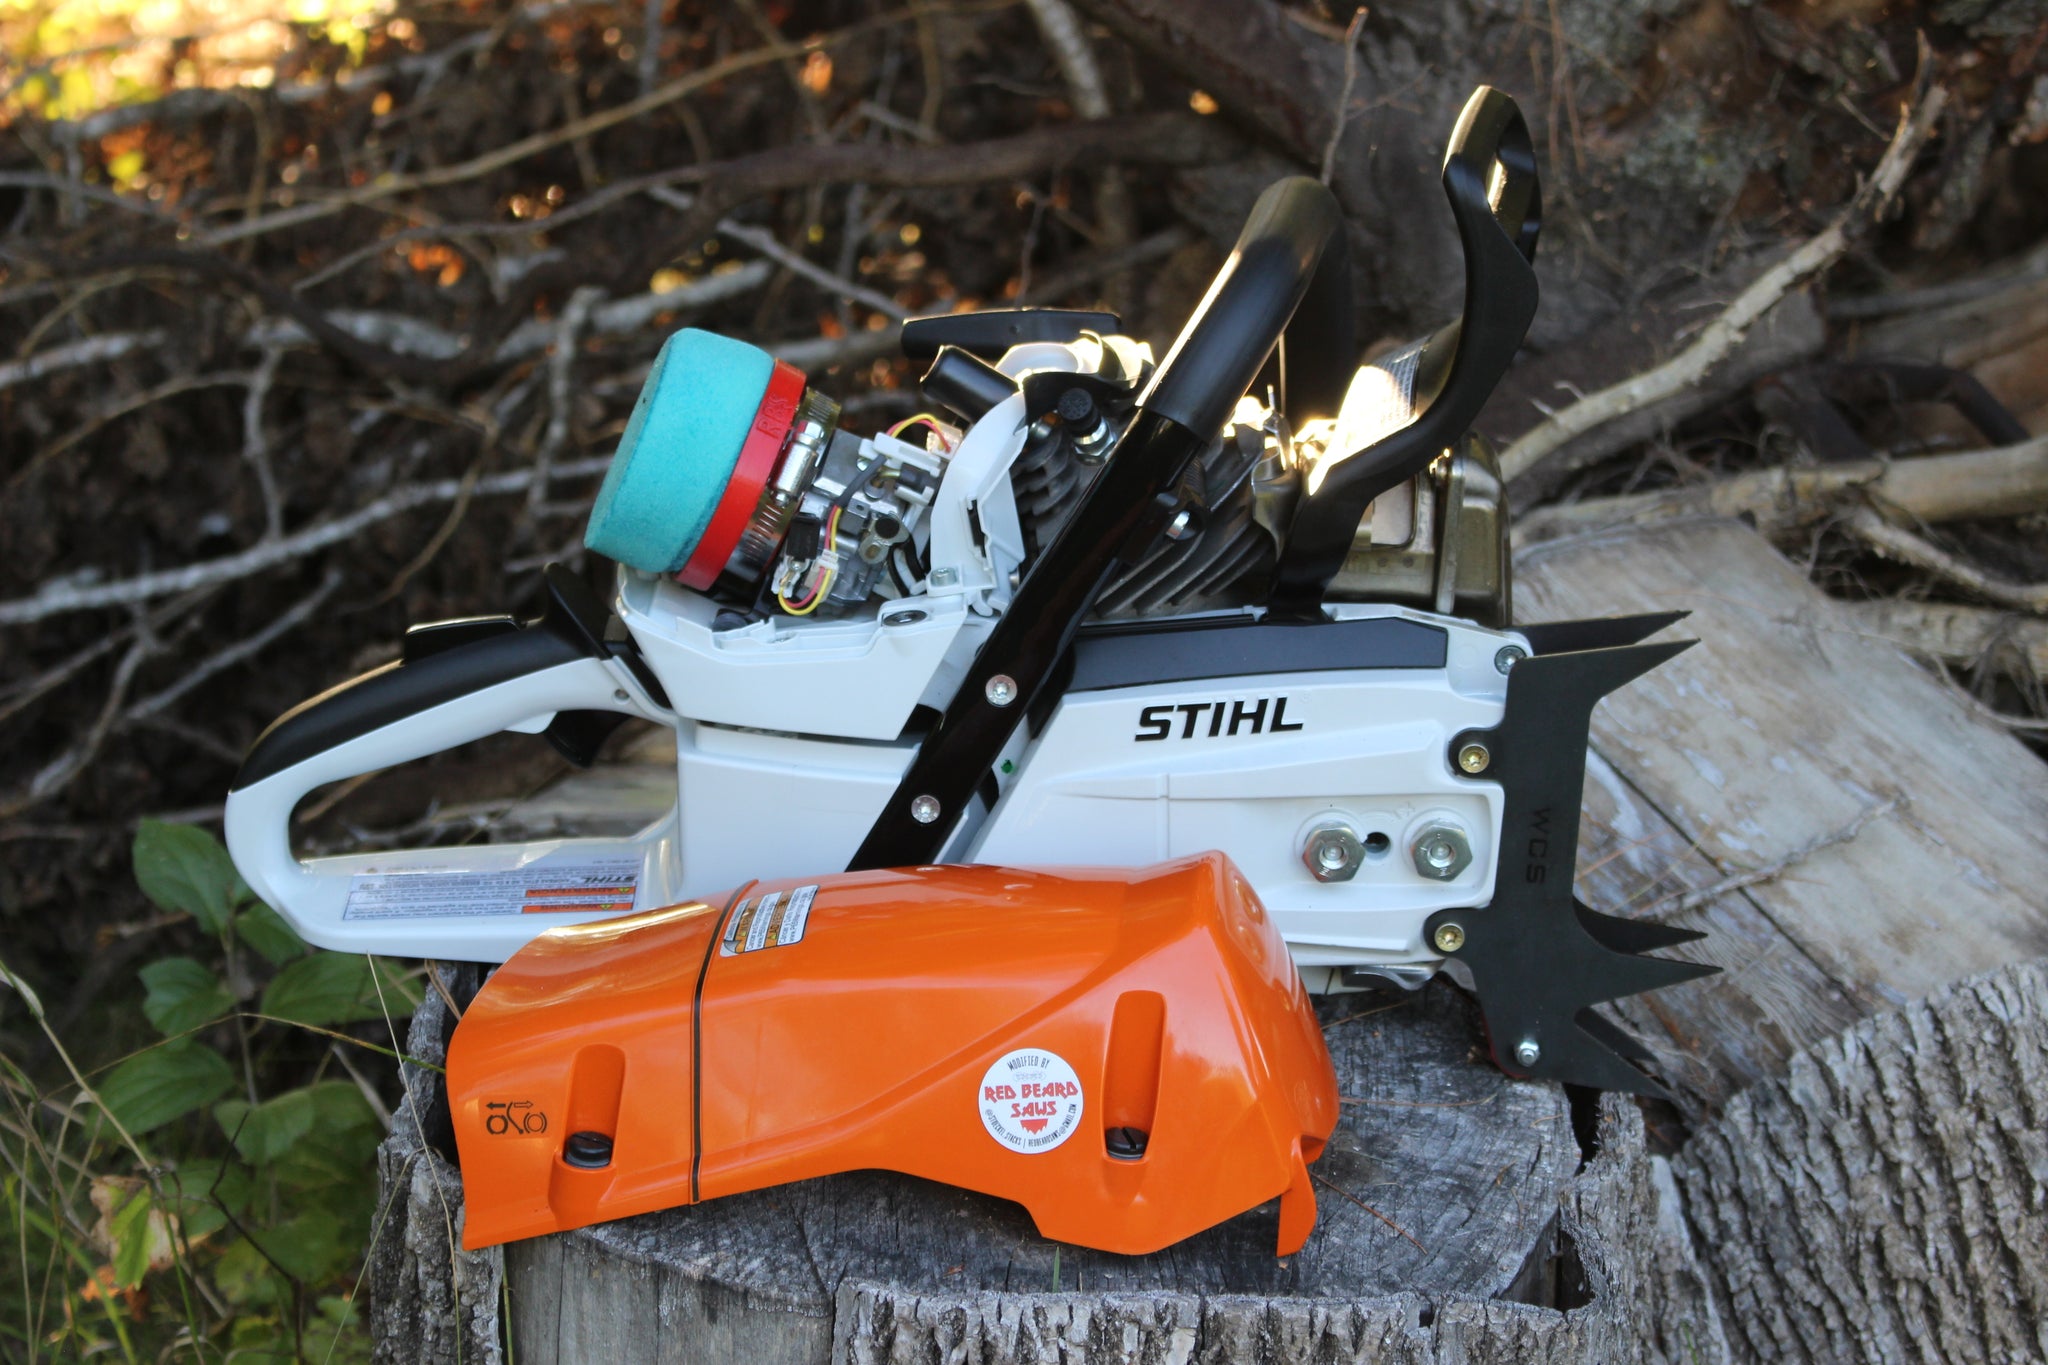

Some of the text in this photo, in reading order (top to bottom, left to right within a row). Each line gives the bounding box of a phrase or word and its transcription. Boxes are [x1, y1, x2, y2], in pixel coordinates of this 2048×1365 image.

[1134, 697, 1303, 742] STIHL
[1526, 807, 1552, 885] WCS
[582, 876, 636, 884] STIHL
[1007, 1055, 1051, 1071] MODIFIED BY
[984, 1081, 1079, 1103] RED BEARD
[1010, 1101, 1057, 1118] SAWS
